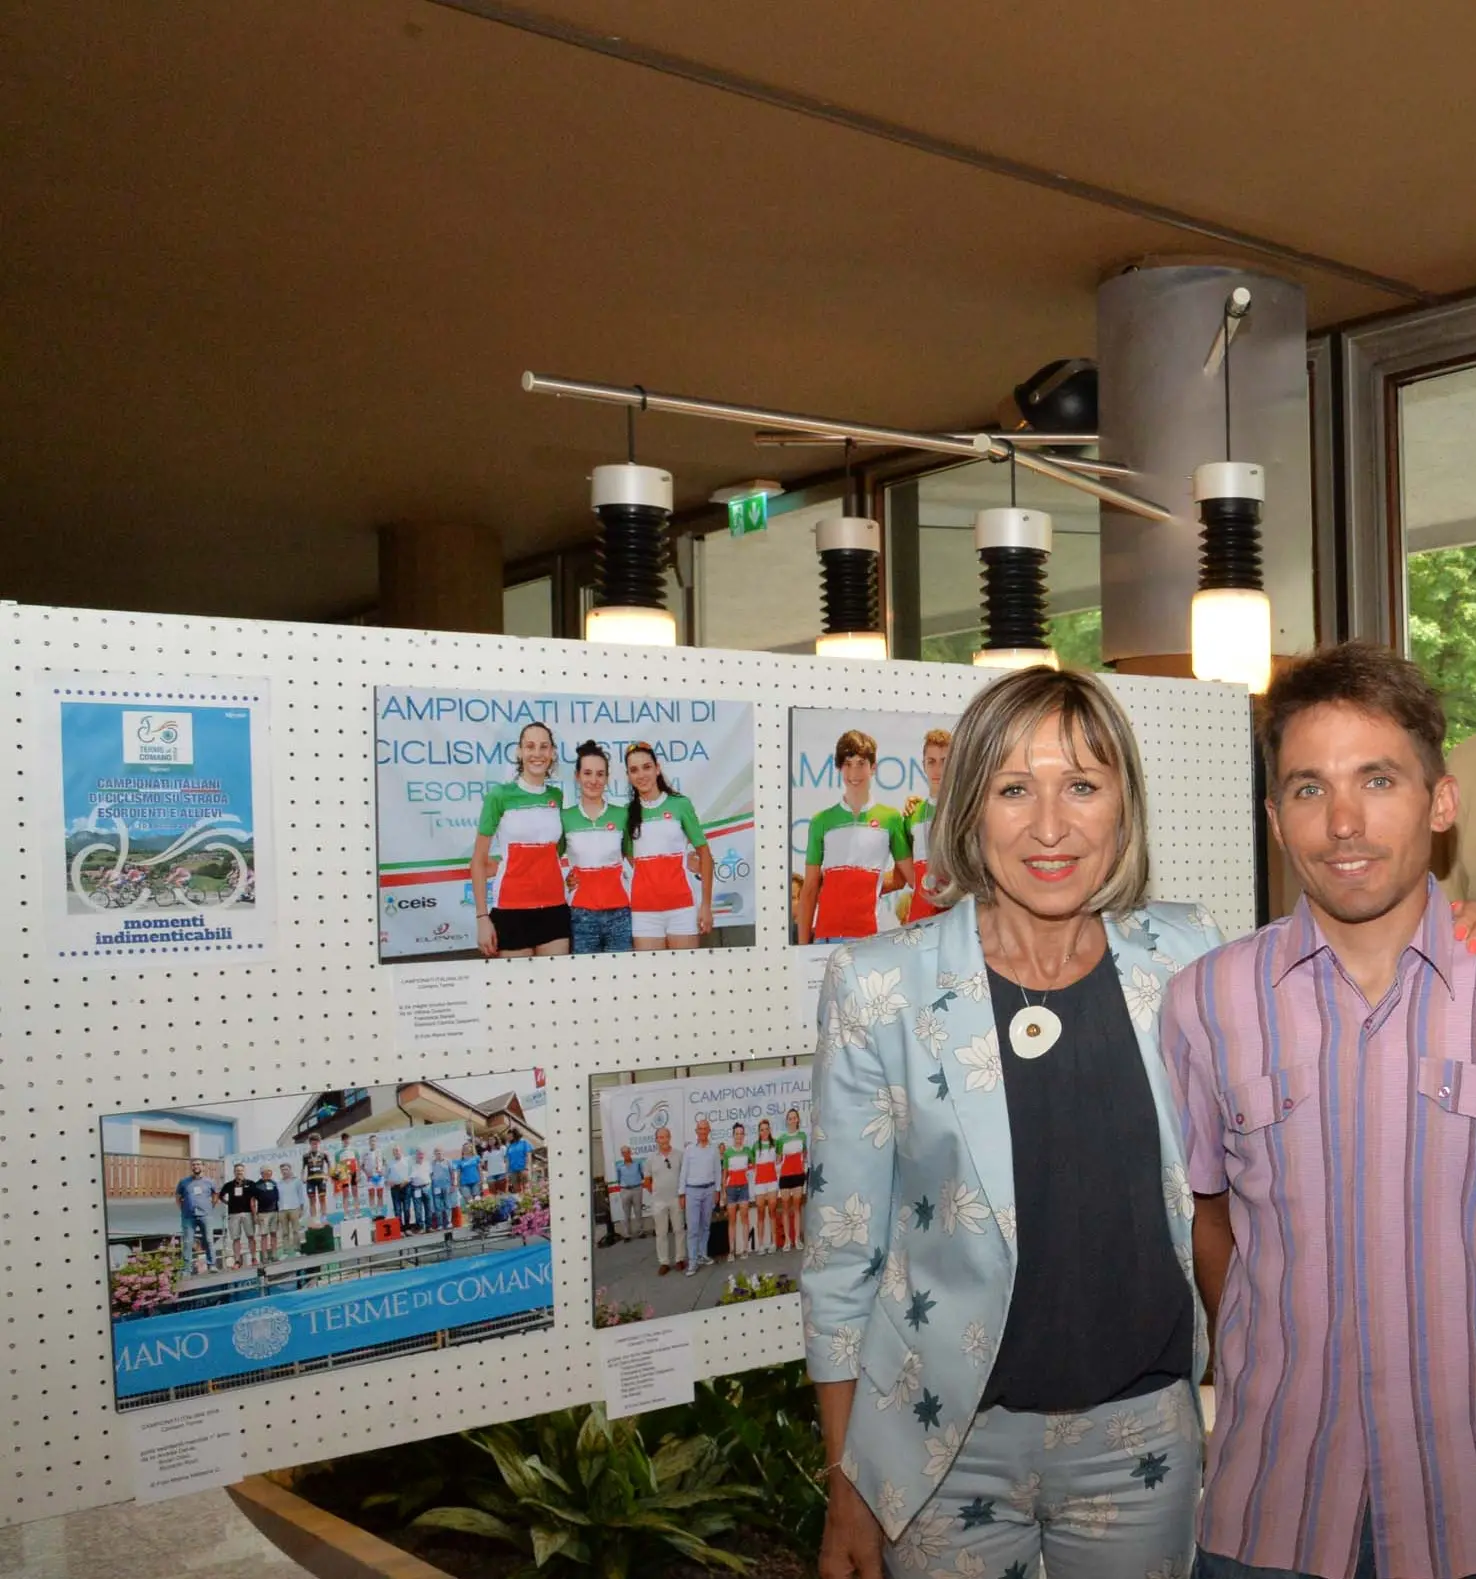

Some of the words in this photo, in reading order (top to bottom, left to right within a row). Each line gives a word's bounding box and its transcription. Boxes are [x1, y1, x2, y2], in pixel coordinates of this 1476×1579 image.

[377, 695, 559, 724] AMPIONATI
[570, 700, 680, 724] ITALIANI
[691, 700, 716, 723] DI
[97, 778, 170, 790] CAMPIONATI
[173, 779, 220, 790] ITALIANI
[106, 793, 162, 804] CICLISMO
[164, 794, 181, 804] SU
[183, 794, 229, 805] STRADA
[97, 807, 167, 818] ESORDIENTI
[180, 808, 222, 818] ALLIEVI
[398, 896, 437, 910] ceis
[123, 914, 206, 930] momenti
[95, 927, 233, 945] indimenticabili
[689, 1083, 776, 1104] CAMPIONATI
[766, 1102, 786, 1117] SU
[302, 1291, 410, 1335] TERME
[413, 1290, 433, 1309] DI
